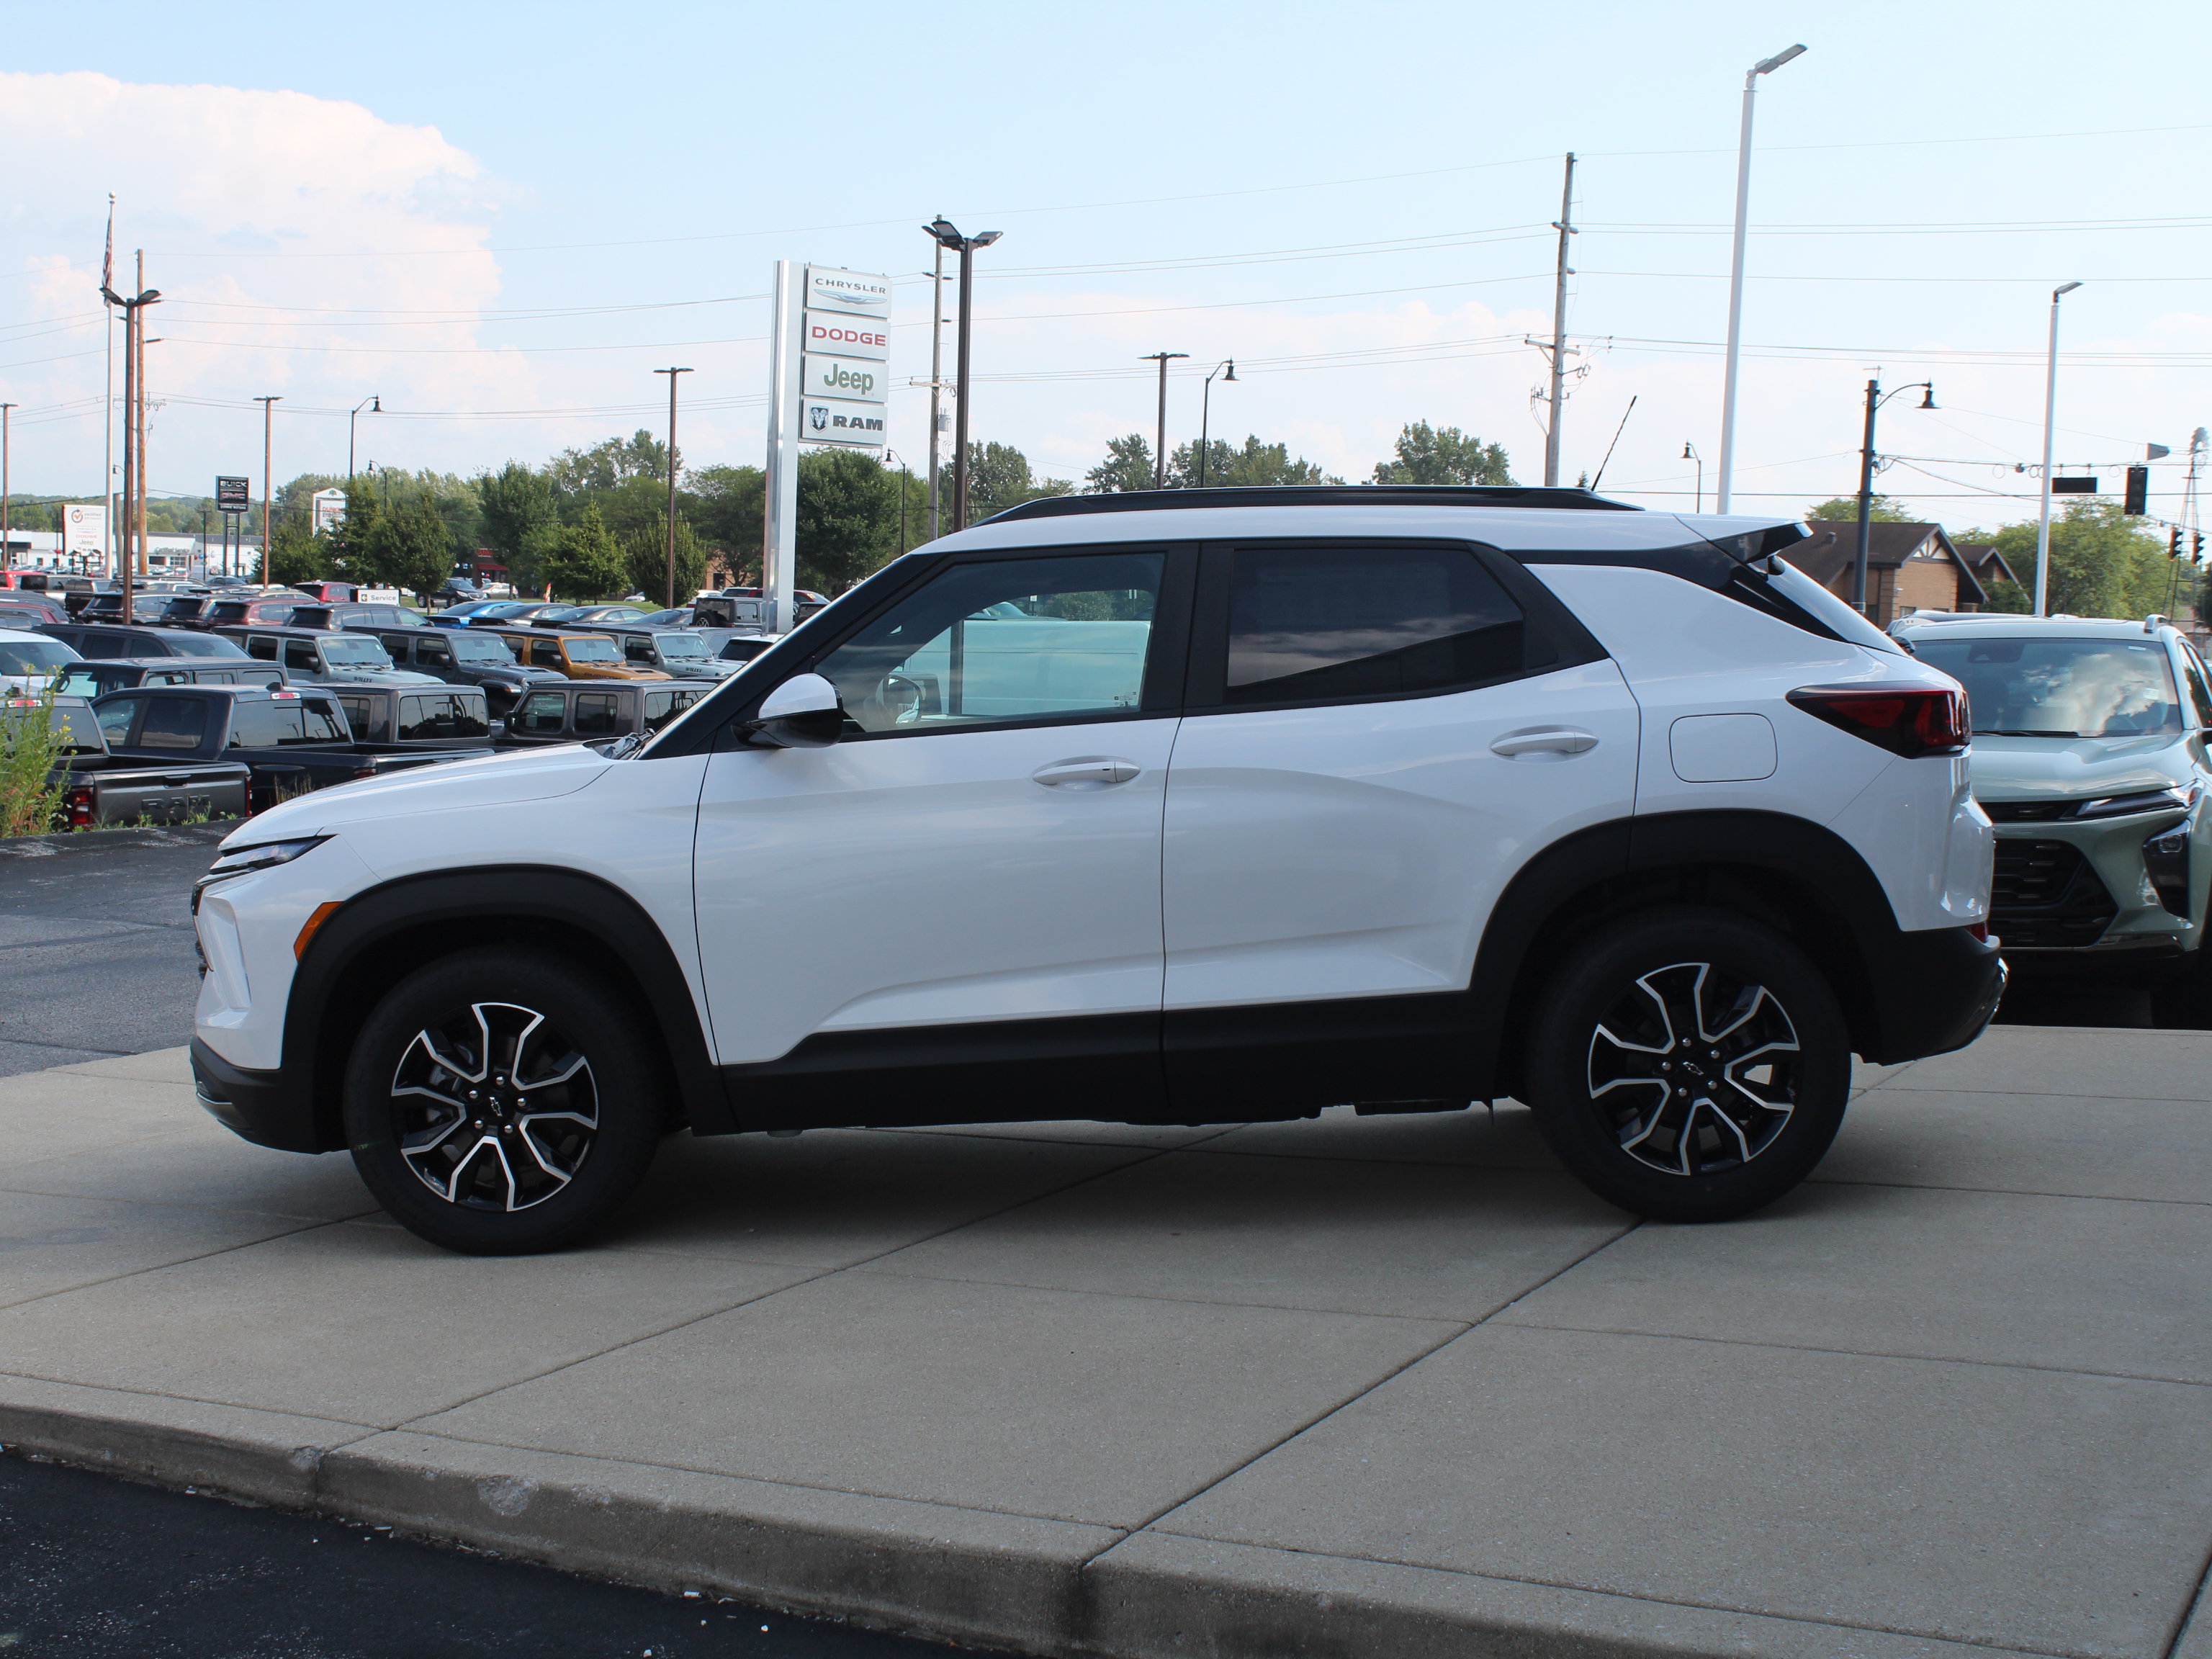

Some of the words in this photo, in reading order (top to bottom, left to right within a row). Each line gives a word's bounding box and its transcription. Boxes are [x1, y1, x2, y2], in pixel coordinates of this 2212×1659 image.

[815, 278, 886, 295] CHRYSLER
[812, 326, 886, 346] DODGE
[824, 364, 874, 395] Jeep
[832, 415, 884, 431] RAM
[141, 794, 211, 811] RAM
